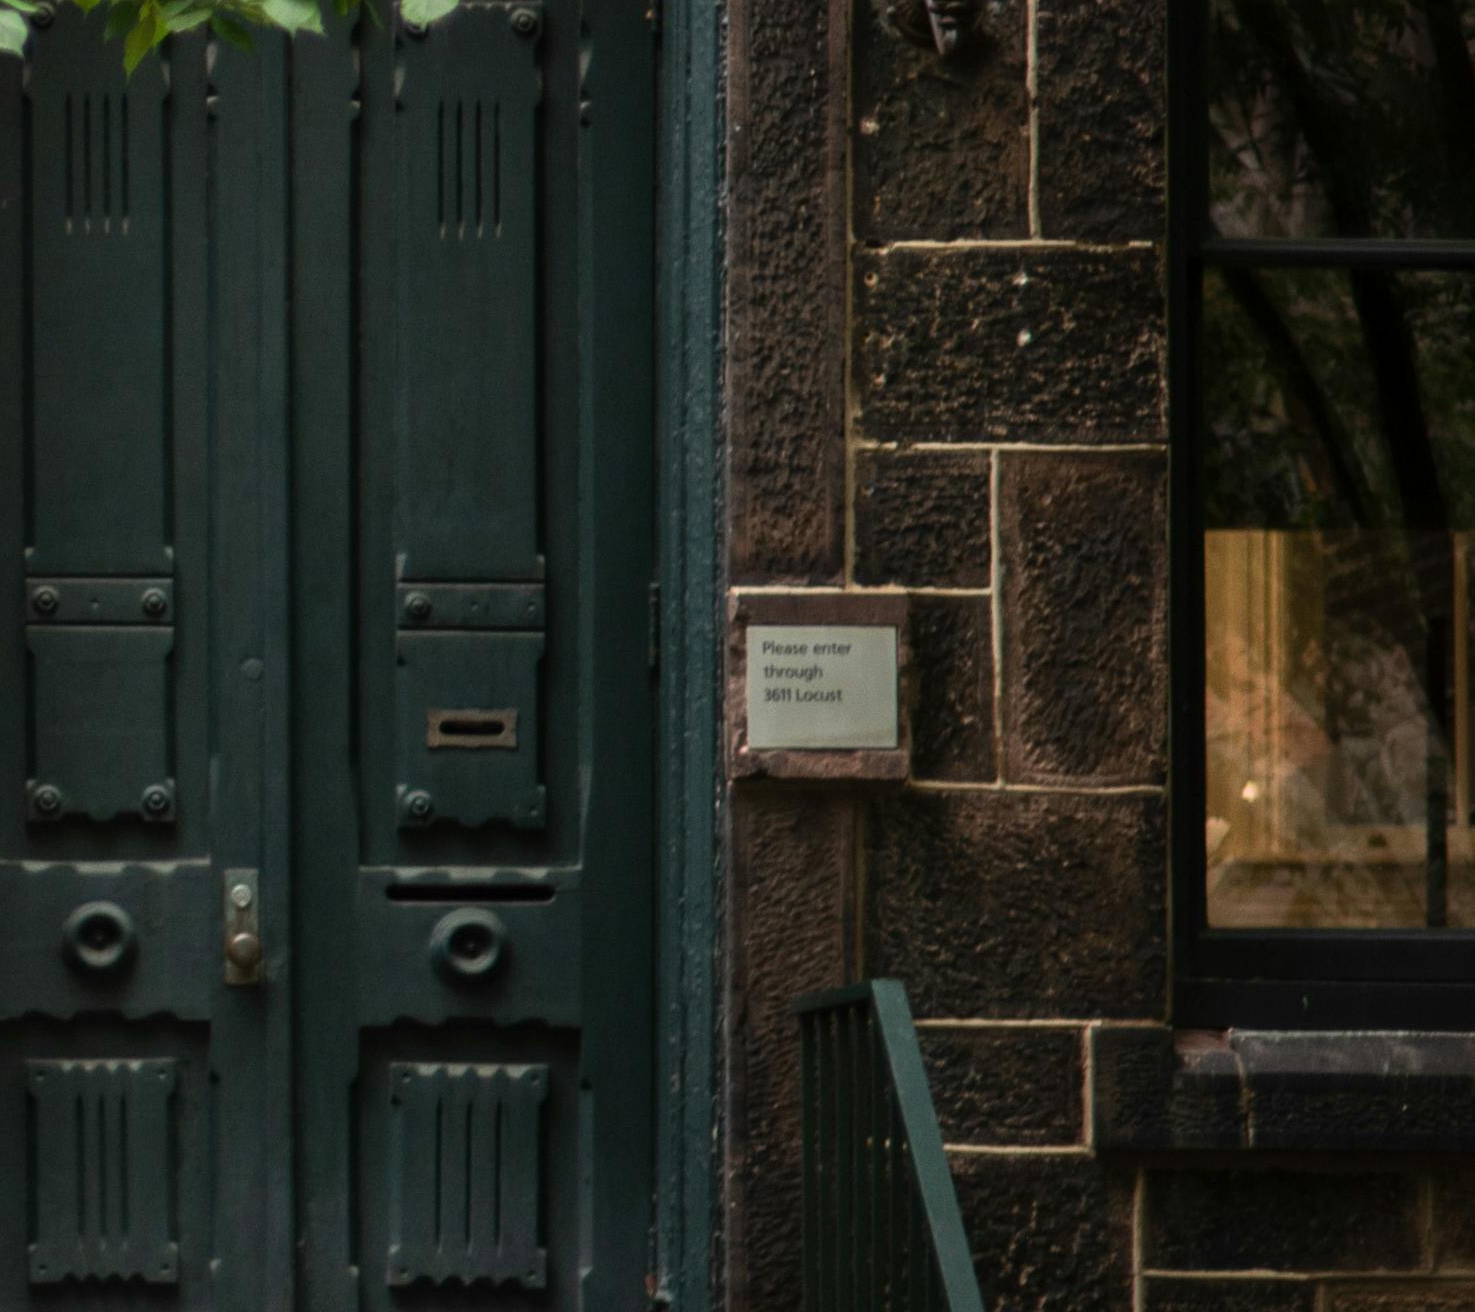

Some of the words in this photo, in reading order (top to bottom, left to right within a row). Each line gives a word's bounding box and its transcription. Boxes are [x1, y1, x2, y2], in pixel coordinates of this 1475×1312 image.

[762, 641, 808, 655] Please
[812, 642, 852, 655] enter
[763, 664, 823, 682] through
[764, 689, 792, 702] 3611
[796, 689, 843, 702] Locust
